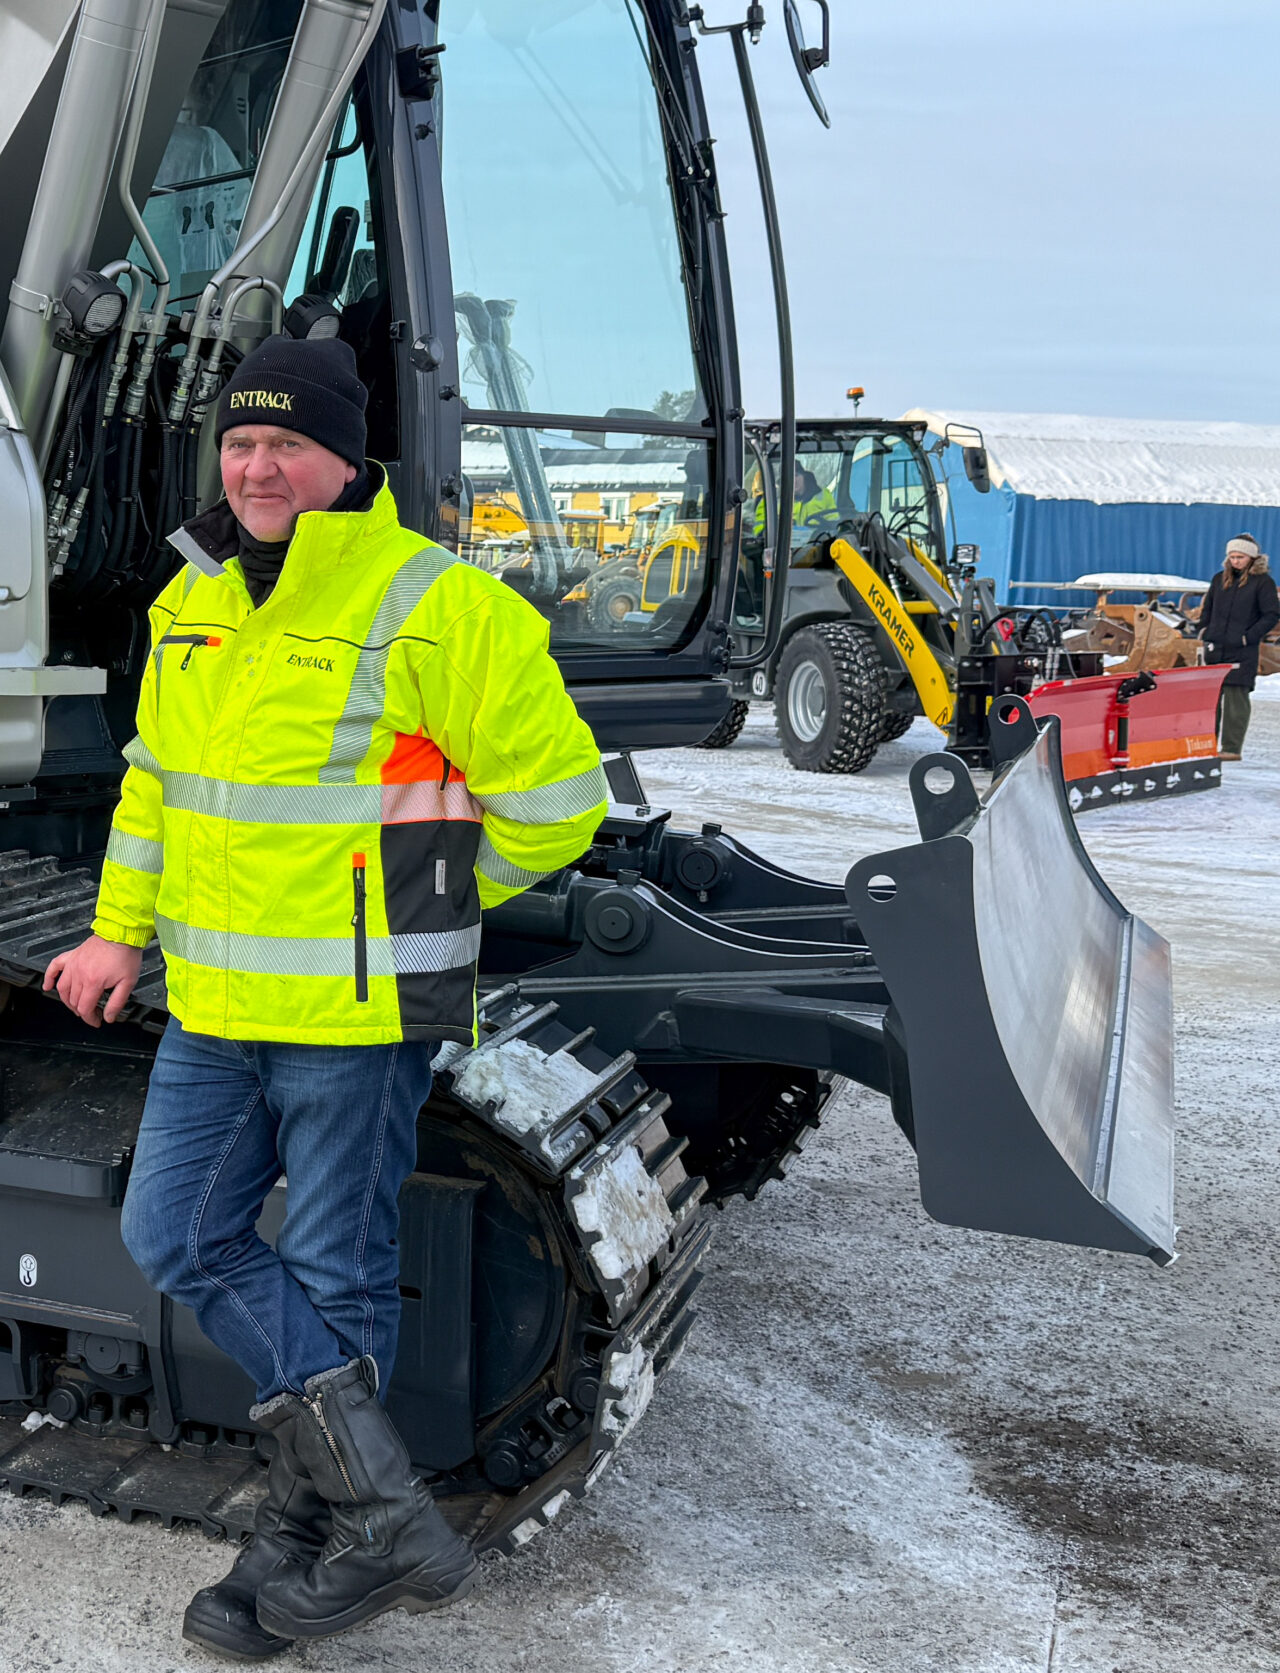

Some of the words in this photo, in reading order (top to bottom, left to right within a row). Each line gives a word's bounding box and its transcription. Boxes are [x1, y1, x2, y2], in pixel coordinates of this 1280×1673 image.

[230, 391, 295, 411] ENTRACK
[869, 583, 914, 659] KRAMER
[287, 654, 335, 673] ENTRACK
